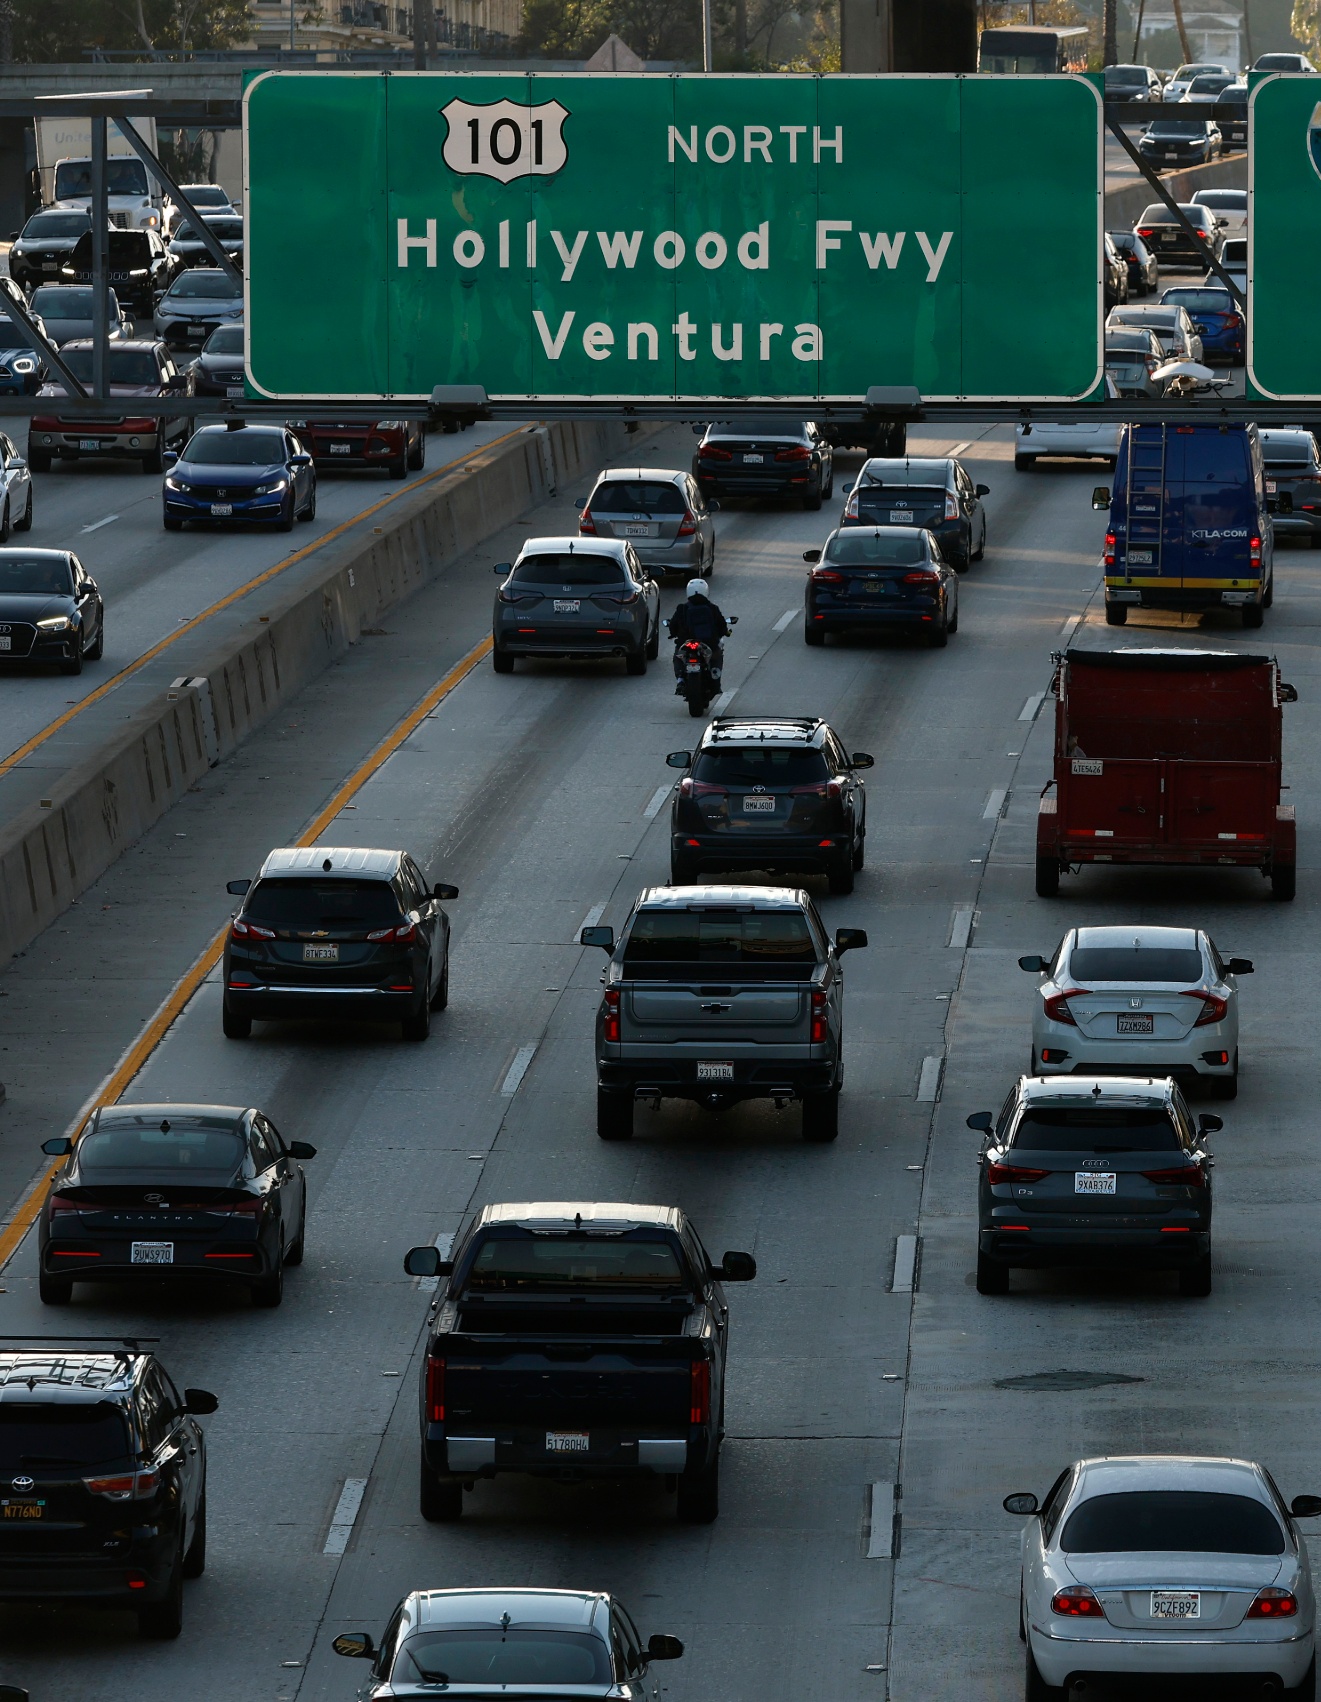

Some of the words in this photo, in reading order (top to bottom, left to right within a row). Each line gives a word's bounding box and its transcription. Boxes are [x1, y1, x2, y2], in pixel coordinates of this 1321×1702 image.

[467, 117, 543, 165] 101
[668, 125, 843, 163] NORTH
[397, 218, 769, 282] Hollywood
[816, 220, 954, 282] Fwy
[532, 311, 823, 361] Ventura
[1119, 1021, 1151, 1031] 7ZXM986
[699, 1068, 731, 1077] 93131B4
[1078, 1180, 1113, 1190] 9XAB376
[134, 1249, 171, 1260] 9UWS970
[1153, 1601, 1198, 1614] 9CZF892
